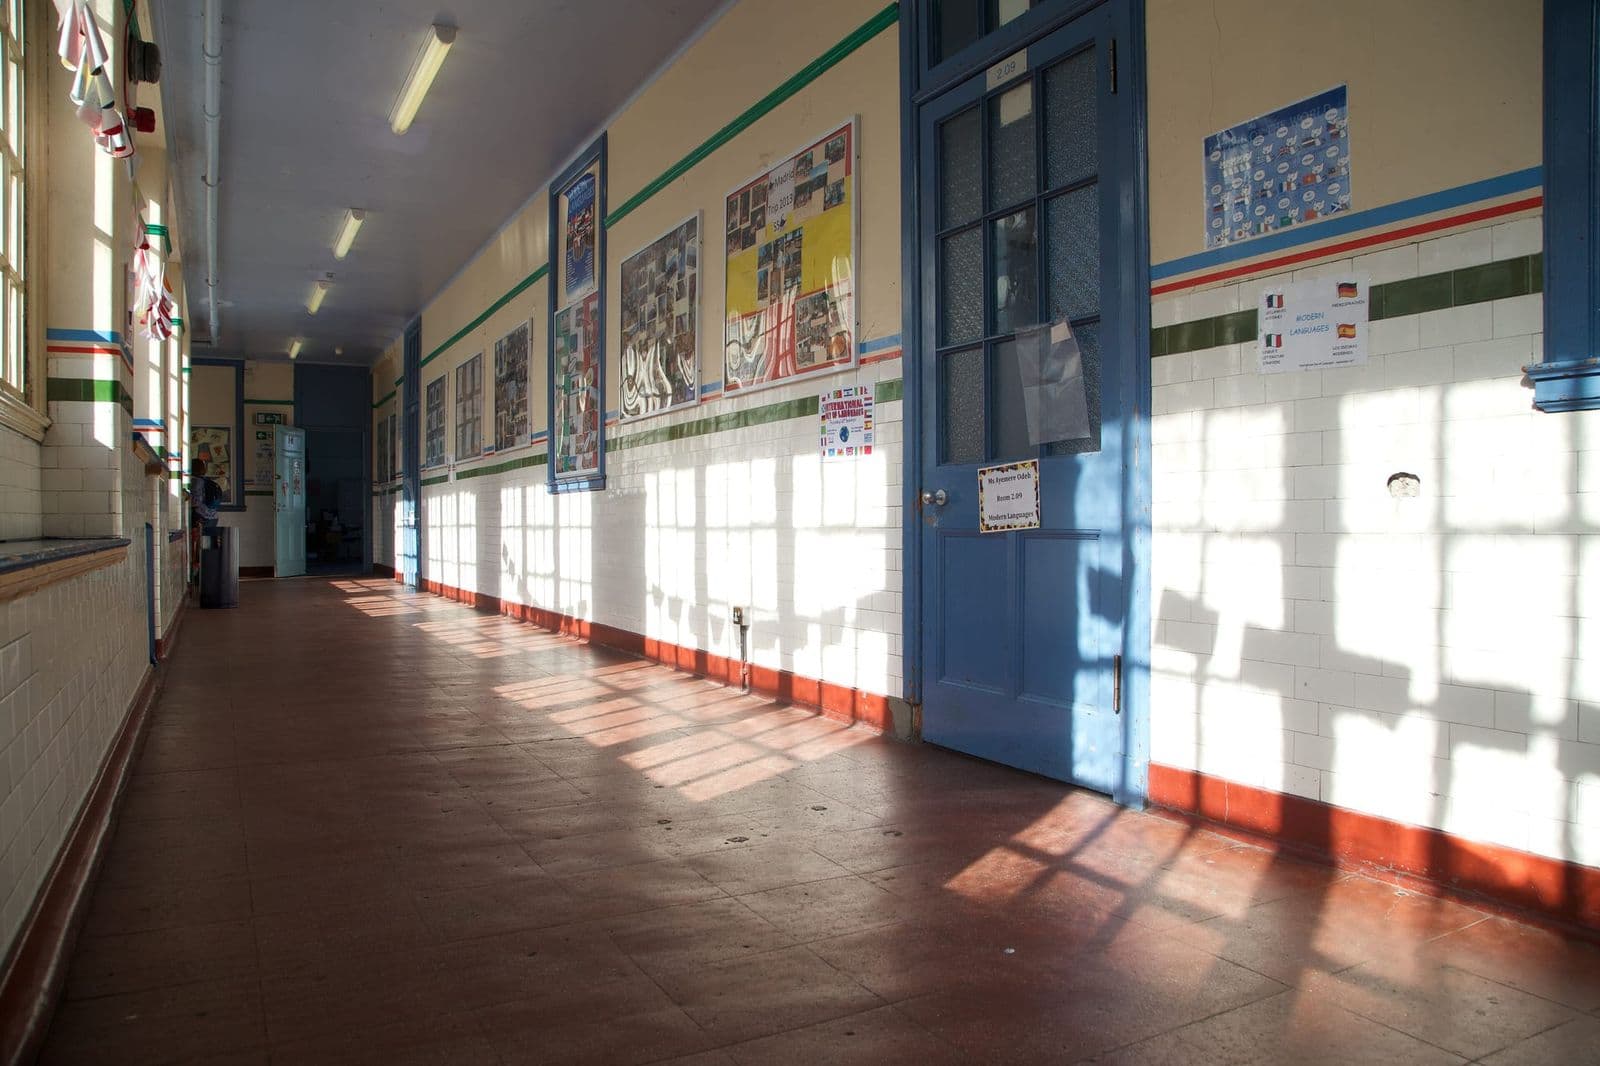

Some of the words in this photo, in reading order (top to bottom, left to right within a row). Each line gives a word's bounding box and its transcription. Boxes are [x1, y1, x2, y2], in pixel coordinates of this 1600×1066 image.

[996, 61, 1016, 79] 2.09
[774, 171, 794, 187] Madrid
[780, 193, 793, 209] 2013
[1296, 312, 1324, 321] MODERN
[1290, 325, 1329, 336] LANGUAGES
[1017, 472, 1031, 480] Odeh
[1011, 492, 1022, 500] 2.09
[988, 513, 1006, 521] Modern
[1007, 511, 1033, 520] Languages
